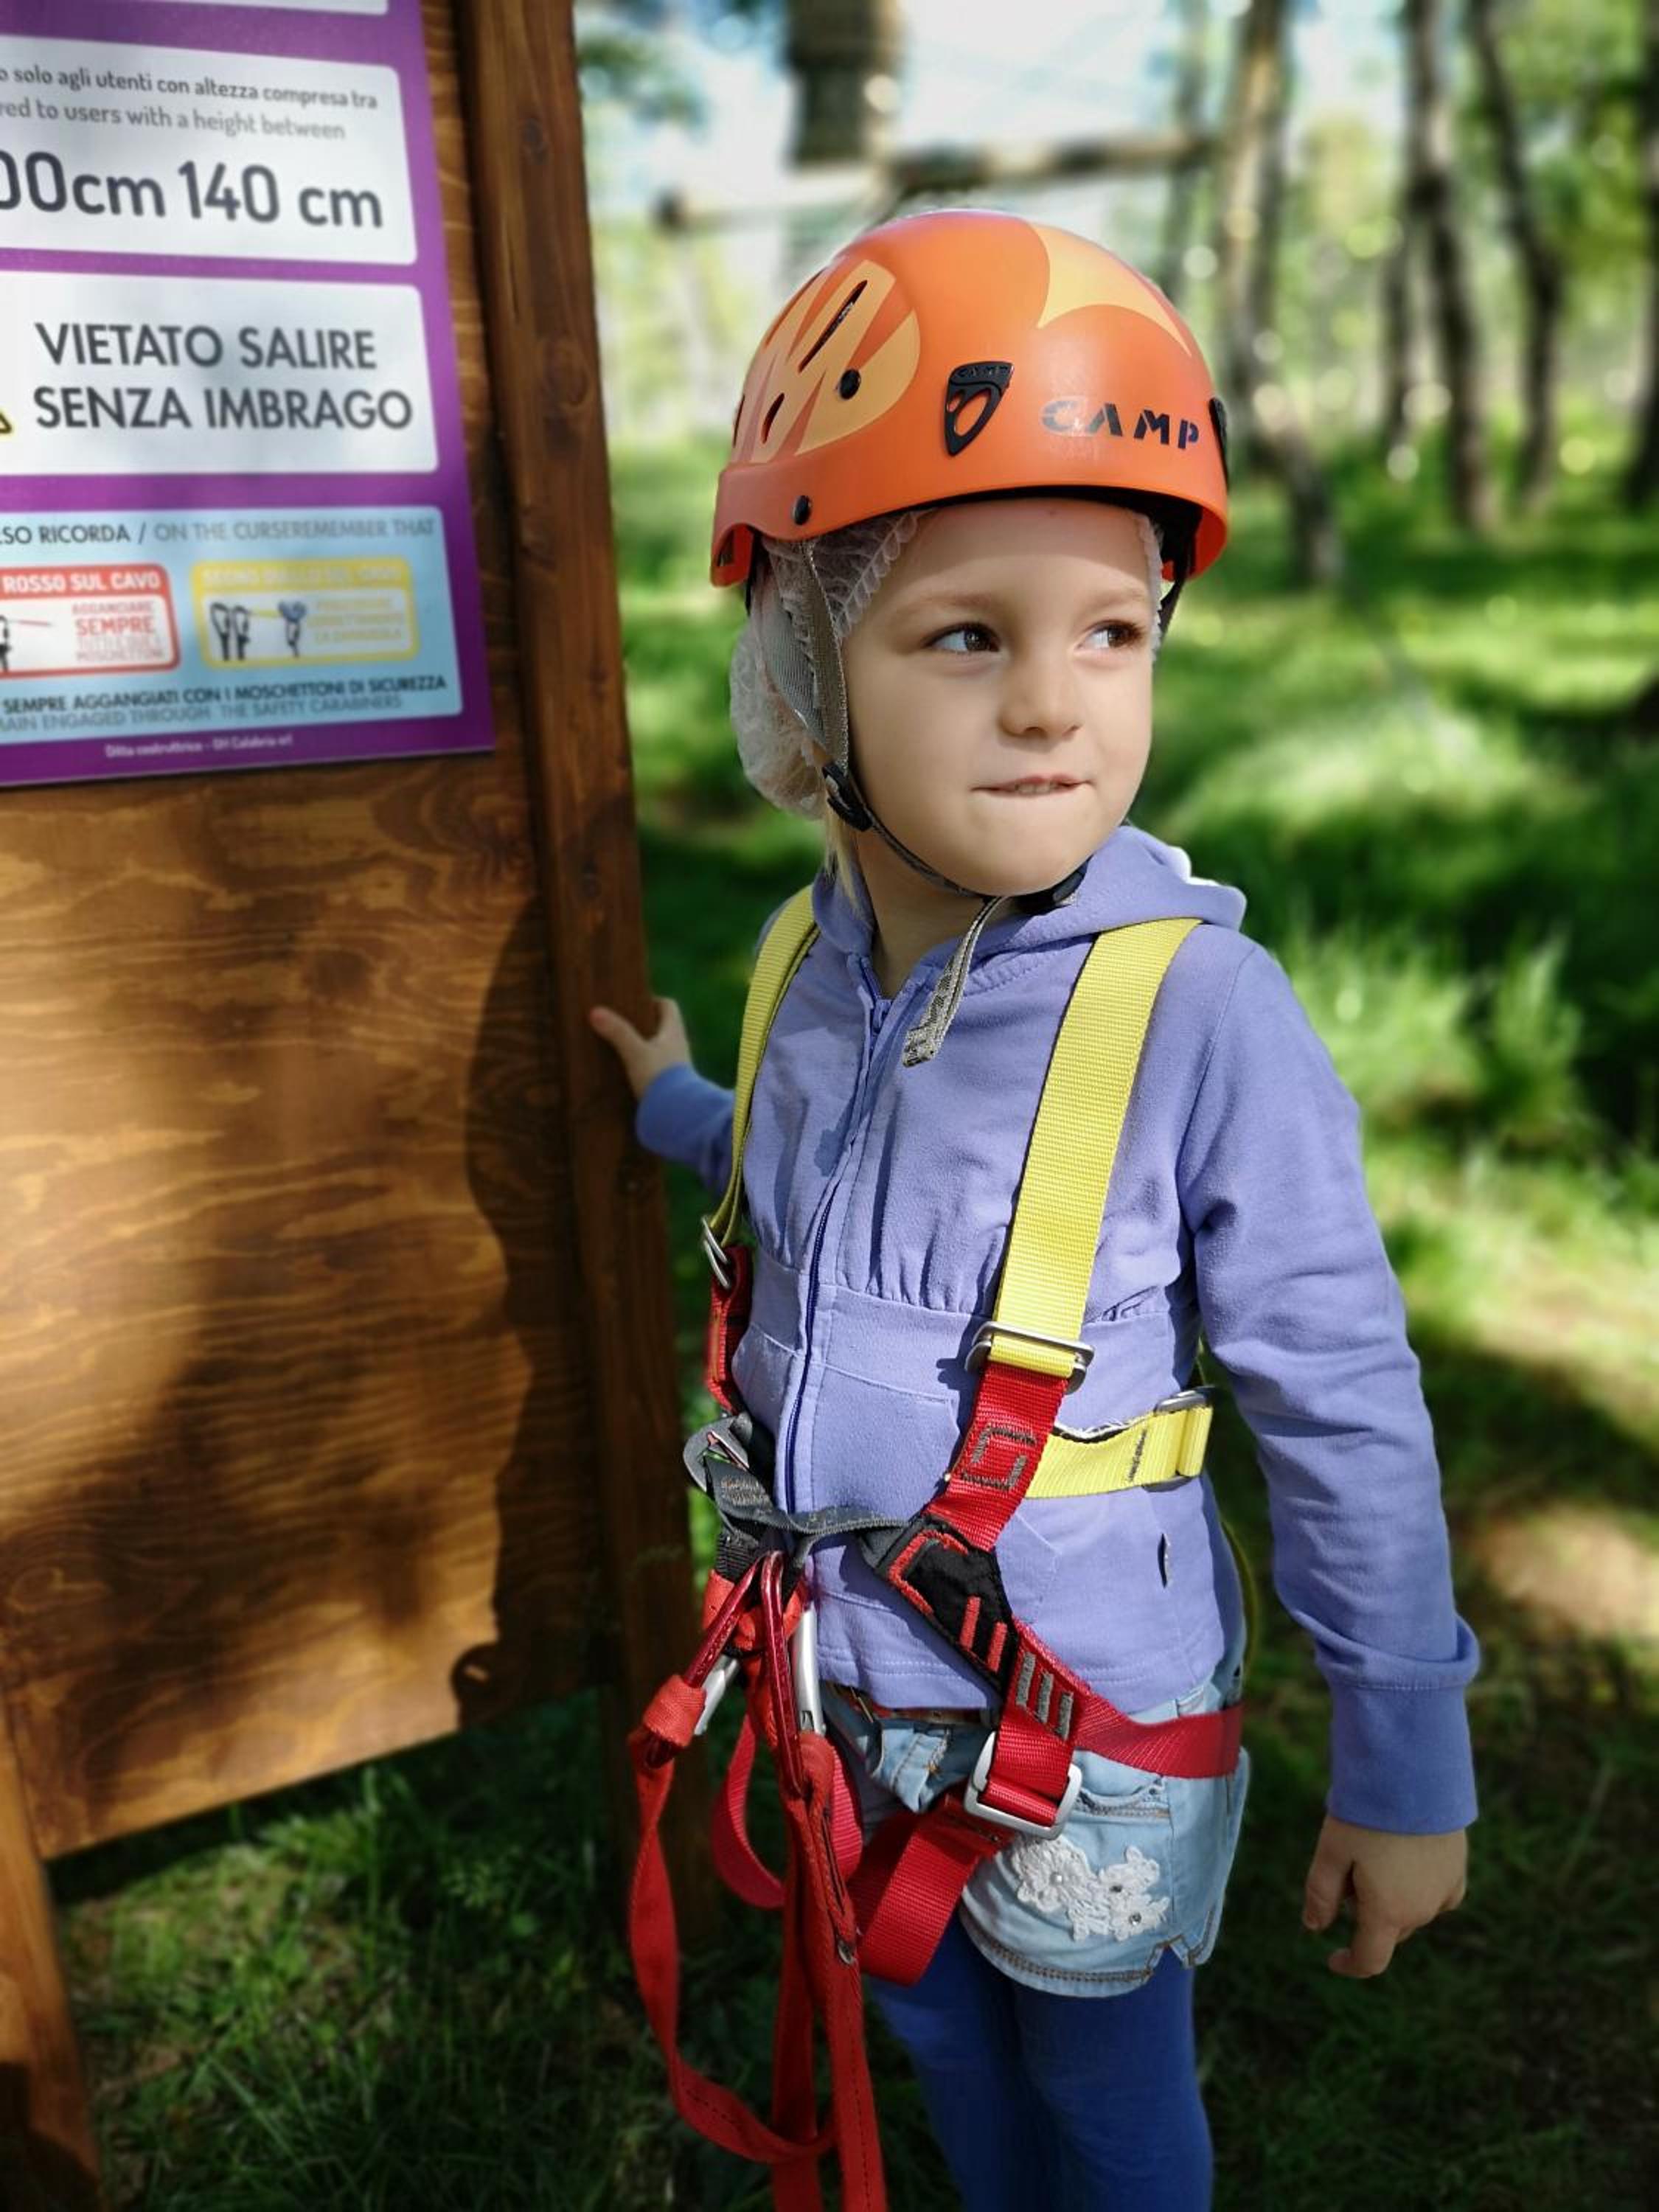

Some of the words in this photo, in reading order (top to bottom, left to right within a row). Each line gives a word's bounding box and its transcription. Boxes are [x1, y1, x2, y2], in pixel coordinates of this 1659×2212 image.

[13, 64, 53, 84] solo
[58, 67, 91, 91] agli
[96, 71, 153, 91] utenti
[157, 78, 190, 93] con
[195, 76, 259, 100] altezza
[262, 87, 349, 108] compresa
[351, 90, 378, 110] tra
[0, 96, 31, 118] ed
[35, 99, 58, 119] to
[63, 105, 121, 125] users
[126, 106, 173, 128] with
[178, 114, 189, 129] a
[193, 108, 257, 138] height
[261, 114, 347, 139] between
[178, 160, 281, 224] 140
[298, 186, 384, 229] cm
[35, 321, 224, 367] VIETATO
[239, 326, 378, 370] SALIRE
[34, 386, 192, 429] SENZA
[204, 388, 413, 431] IMBRAGO
[1041, 399, 1200, 450] CAMP
[0, 525, 32, 545] SO
[38, 524, 131, 544] RICORDA
[154, 521, 187, 541] ON
[193, 521, 226, 540] THE
[392, 517, 435, 538] THAT
[2, 574, 66, 593] ROSSO
[70, 572, 108, 591] SUL
[111, 570, 161, 589] CAVO
[75, 615, 155, 636] SEMPRE
[3, 695, 66, 715] SEMPRE
[183, 686, 220, 703] CON
[235, 681, 345, 700] MOSCHETTONI
[349, 678, 364, 695] DI
[368, 674, 447, 693] SICUREZZA
[42, 710, 126, 731] ENGAGED
[129, 706, 210, 723] THROUGH
[222, 703, 247, 720] THE
[253, 700, 306, 717] SAFETY
